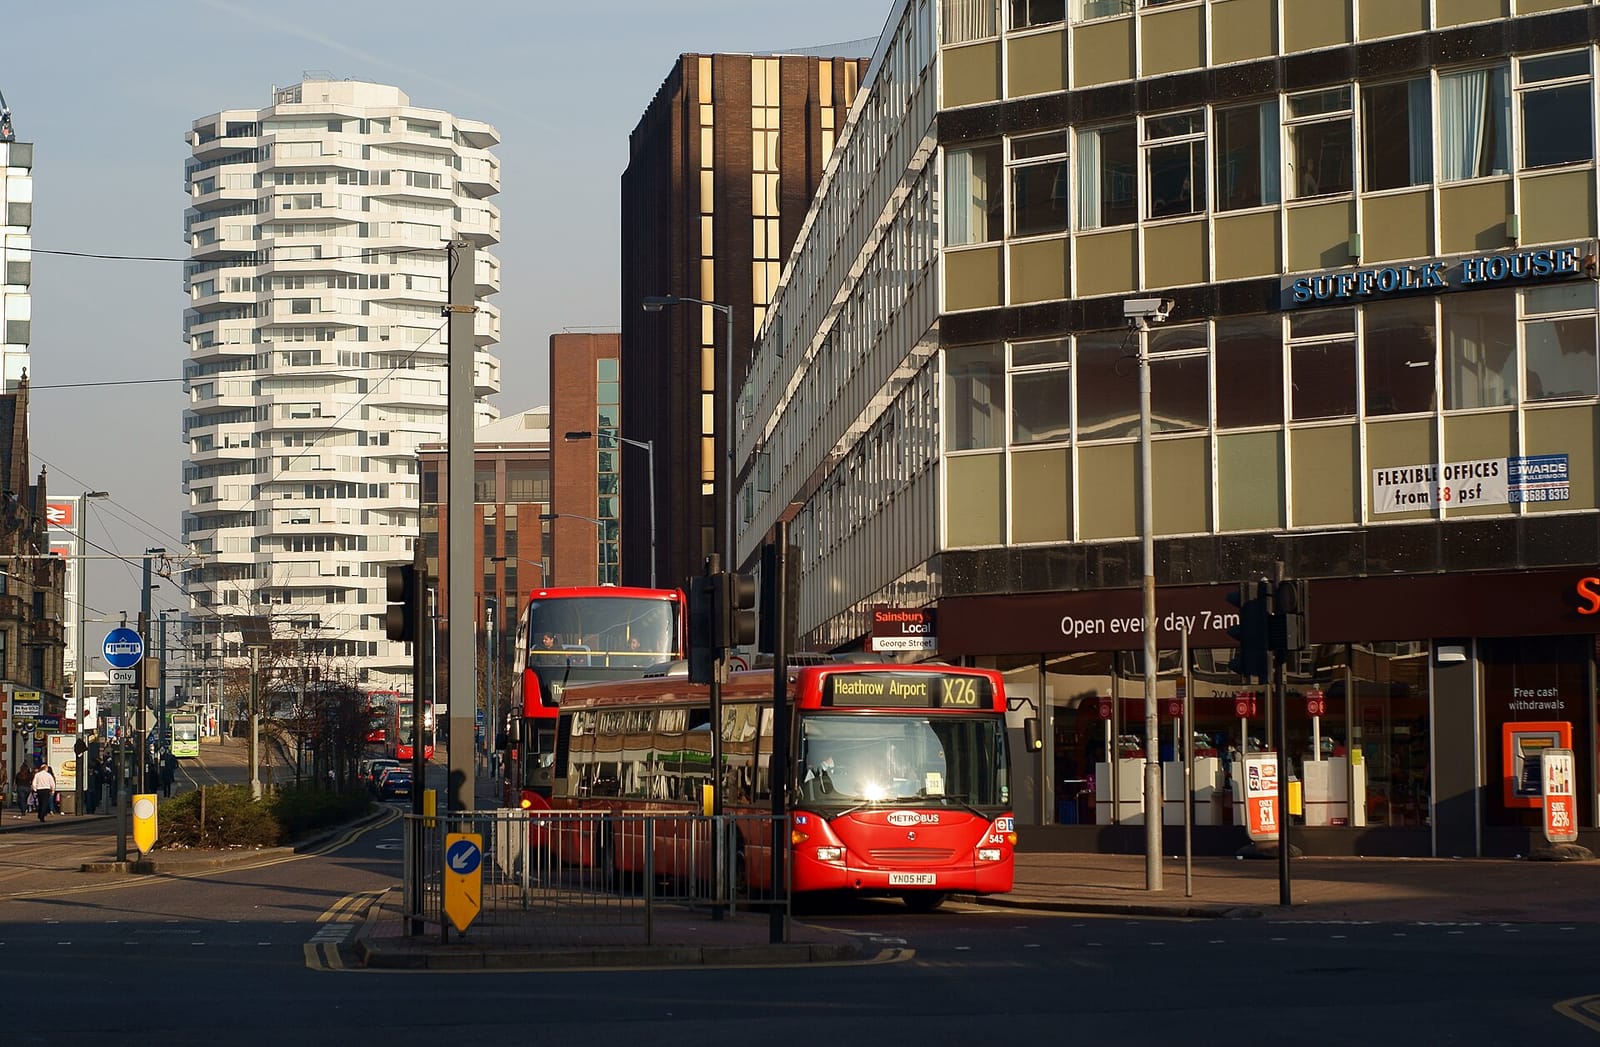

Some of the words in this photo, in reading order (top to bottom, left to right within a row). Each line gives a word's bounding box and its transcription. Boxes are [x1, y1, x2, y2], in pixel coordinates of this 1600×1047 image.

[1292, 262, 1448, 302] SUFFOLK
[1461, 247, 1581, 284] HOUSE
[1377, 467, 1437, 486] FLEXIBLE
[1443, 461, 1500, 481] OFFICES
[1394, 490, 1429, 505] from
[1459, 483, 1482, 503] psf
[1548, 487, 1569, 500] 8313
[901, 622, 931, 633] Local
[1061, 616, 1105, 638] Open
[1163, 612, 1196, 635] day
[1200, 611, 1240, 630] 7am
[879, 639, 907, 648] George
[908, 639, 932, 648] Street
[113, 672, 132, 681] Only
[834, 679, 884, 695] Heathrow
[889, 679, 927, 699] Airport
[943, 678, 976, 704] X26
[1513, 687, 1536, 698] Free
[1536, 687, 1559, 697] cash
[1508, 699, 1565, 711] withdrawals
[888, 813, 940, 824] METROBUS
[1260, 806, 1275, 824] £1
[989, 834, 1004, 844] 545
[892, 874, 914, 883] YN05
[916, 874, 933, 883] HFJ
